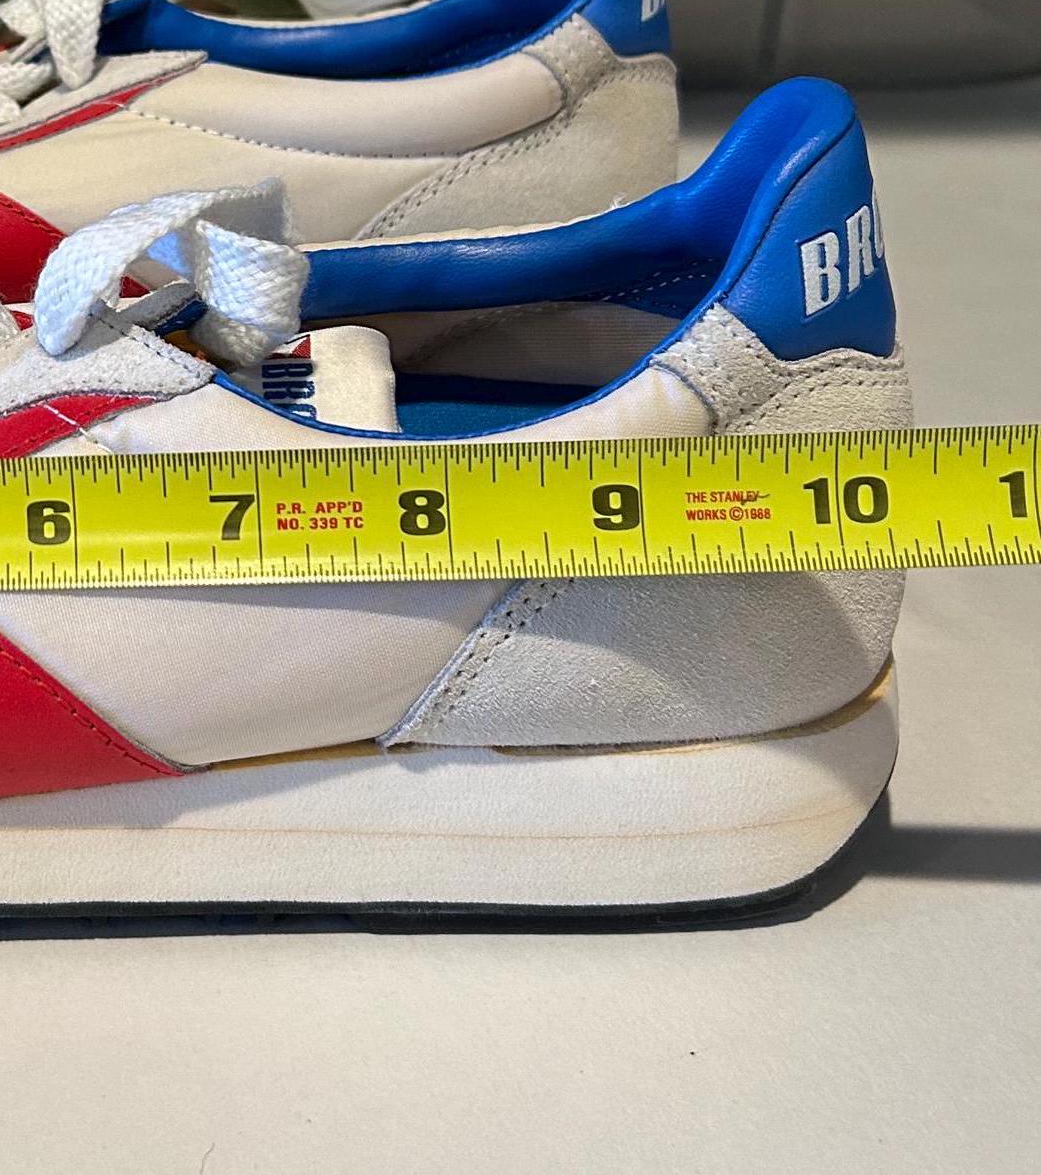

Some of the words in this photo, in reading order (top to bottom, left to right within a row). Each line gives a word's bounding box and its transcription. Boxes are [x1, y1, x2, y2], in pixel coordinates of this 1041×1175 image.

[209, 494, 256, 541] 7
[276, 503, 306, 514] P.R.
[316, 501, 363, 513] APP'D
[399, 490, 446, 536] 8
[592, 484, 640, 530] 9
[685, 492, 707, 503] THE
[686, 509, 726, 521] WORKS
[803, 476, 889, 524] 10
[26, 500, 72, 546] 6
[277, 518, 305, 530] NO.
[309, 517, 338, 529] 339
[343, 517, 364, 528] TC
